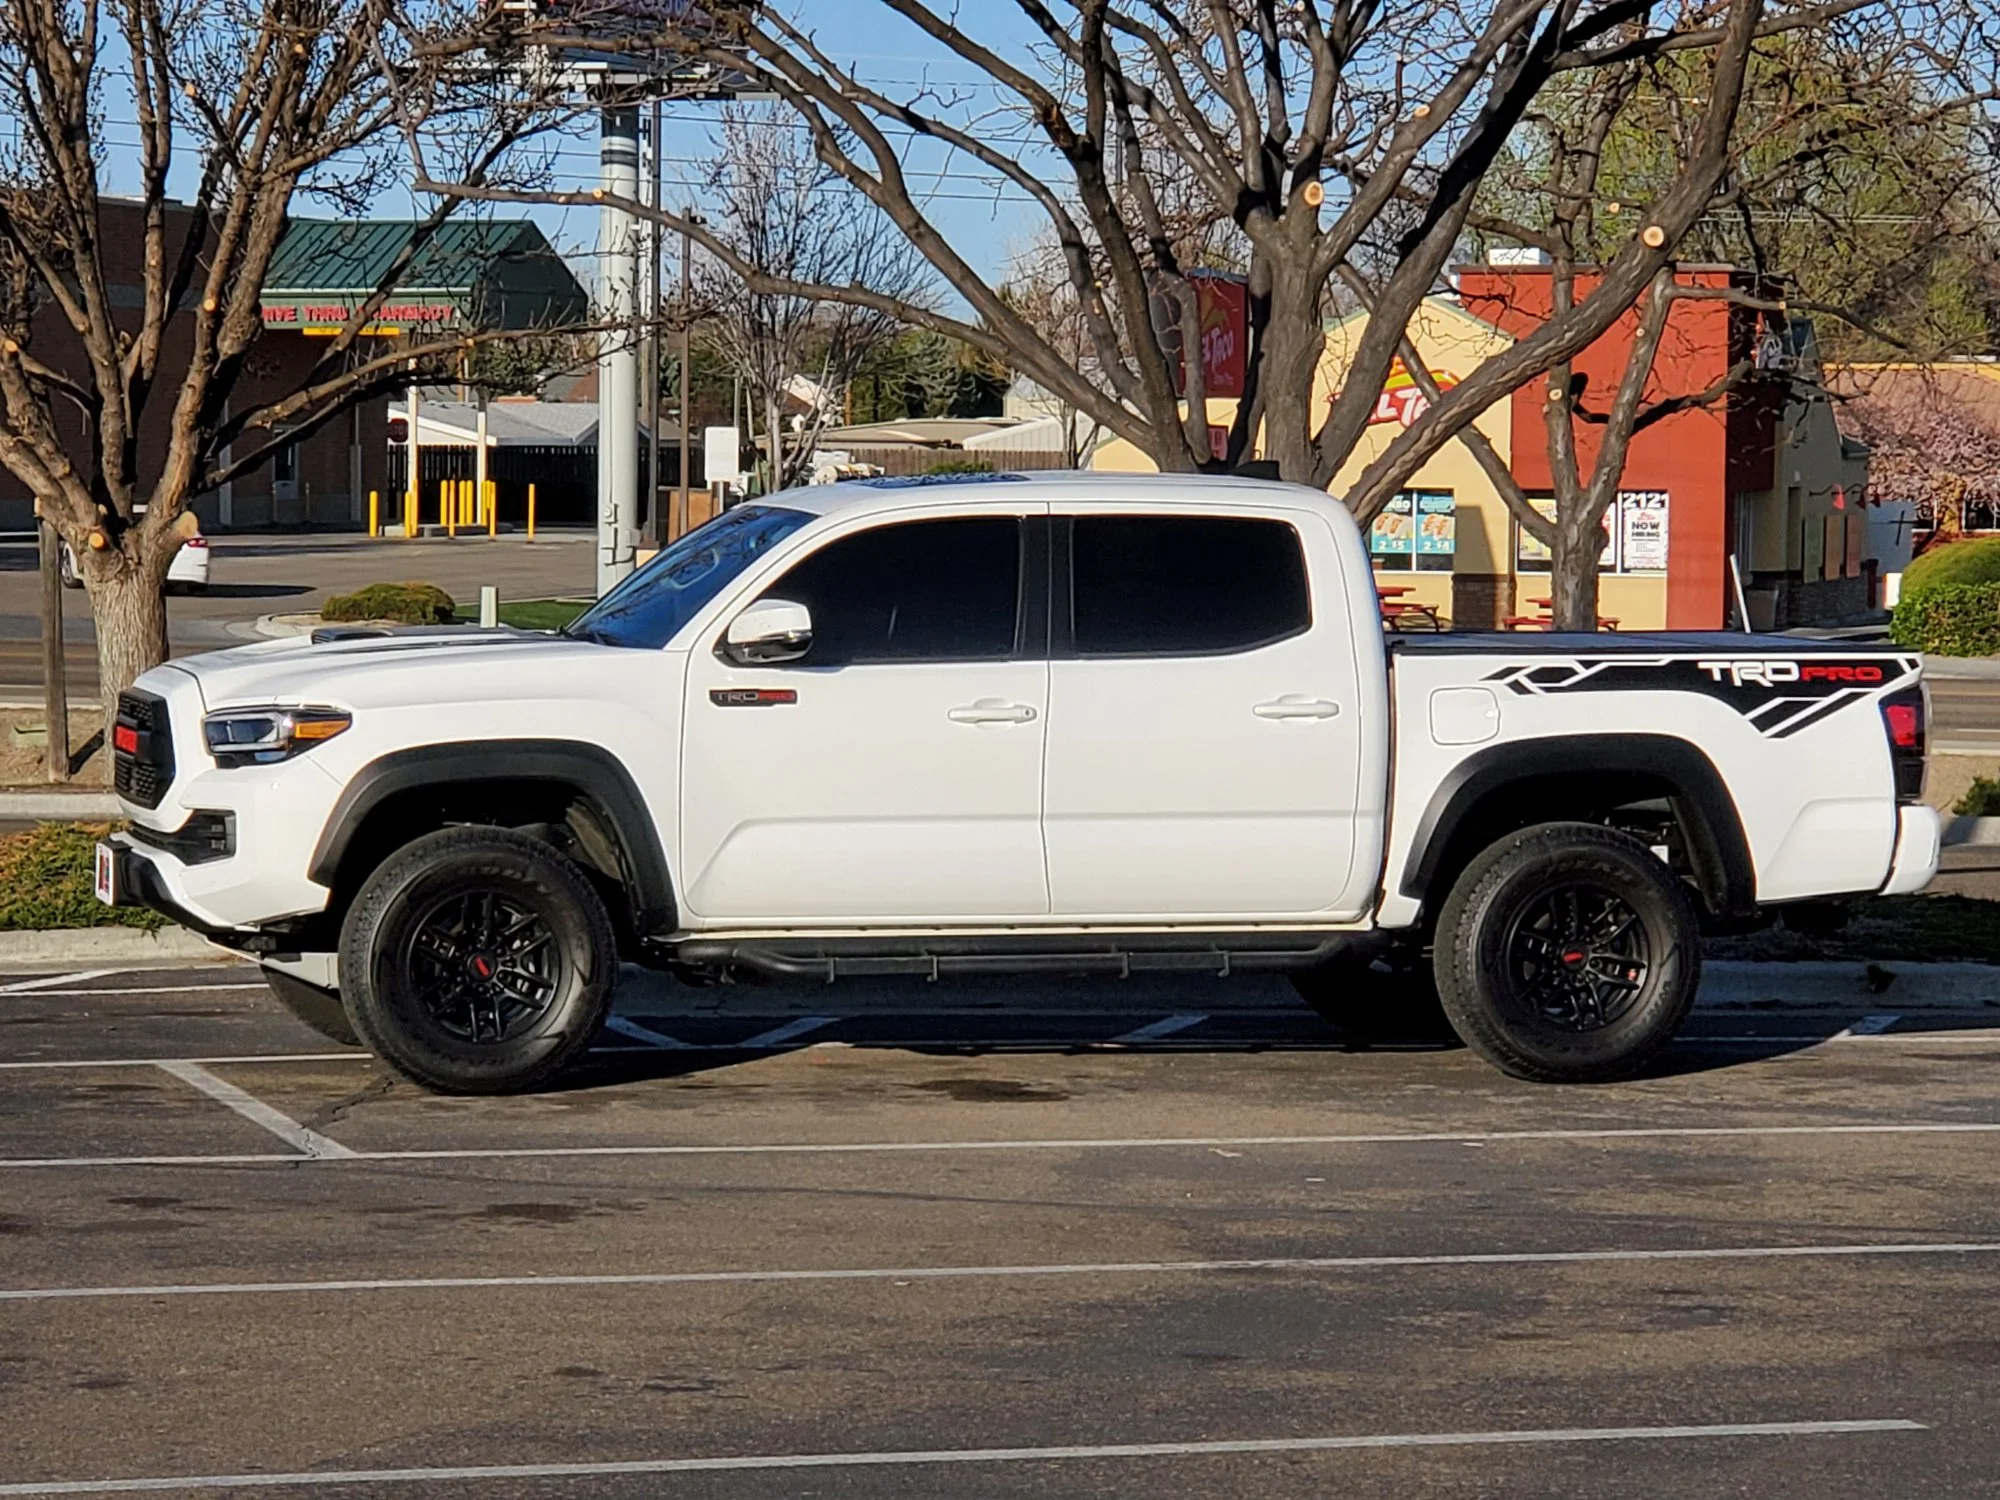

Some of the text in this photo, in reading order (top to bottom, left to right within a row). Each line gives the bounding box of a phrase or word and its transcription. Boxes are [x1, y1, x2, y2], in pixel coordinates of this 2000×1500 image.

[303, 305, 349, 322] THRU
[1622, 492, 1669, 509] 2121
[1631, 521, 1661, 530] NOW
[1378, 540, 1387, 551] 2
[1423, 541, 1432, 552] 2
[1697, 661, 1882, 687] TRD PRO
